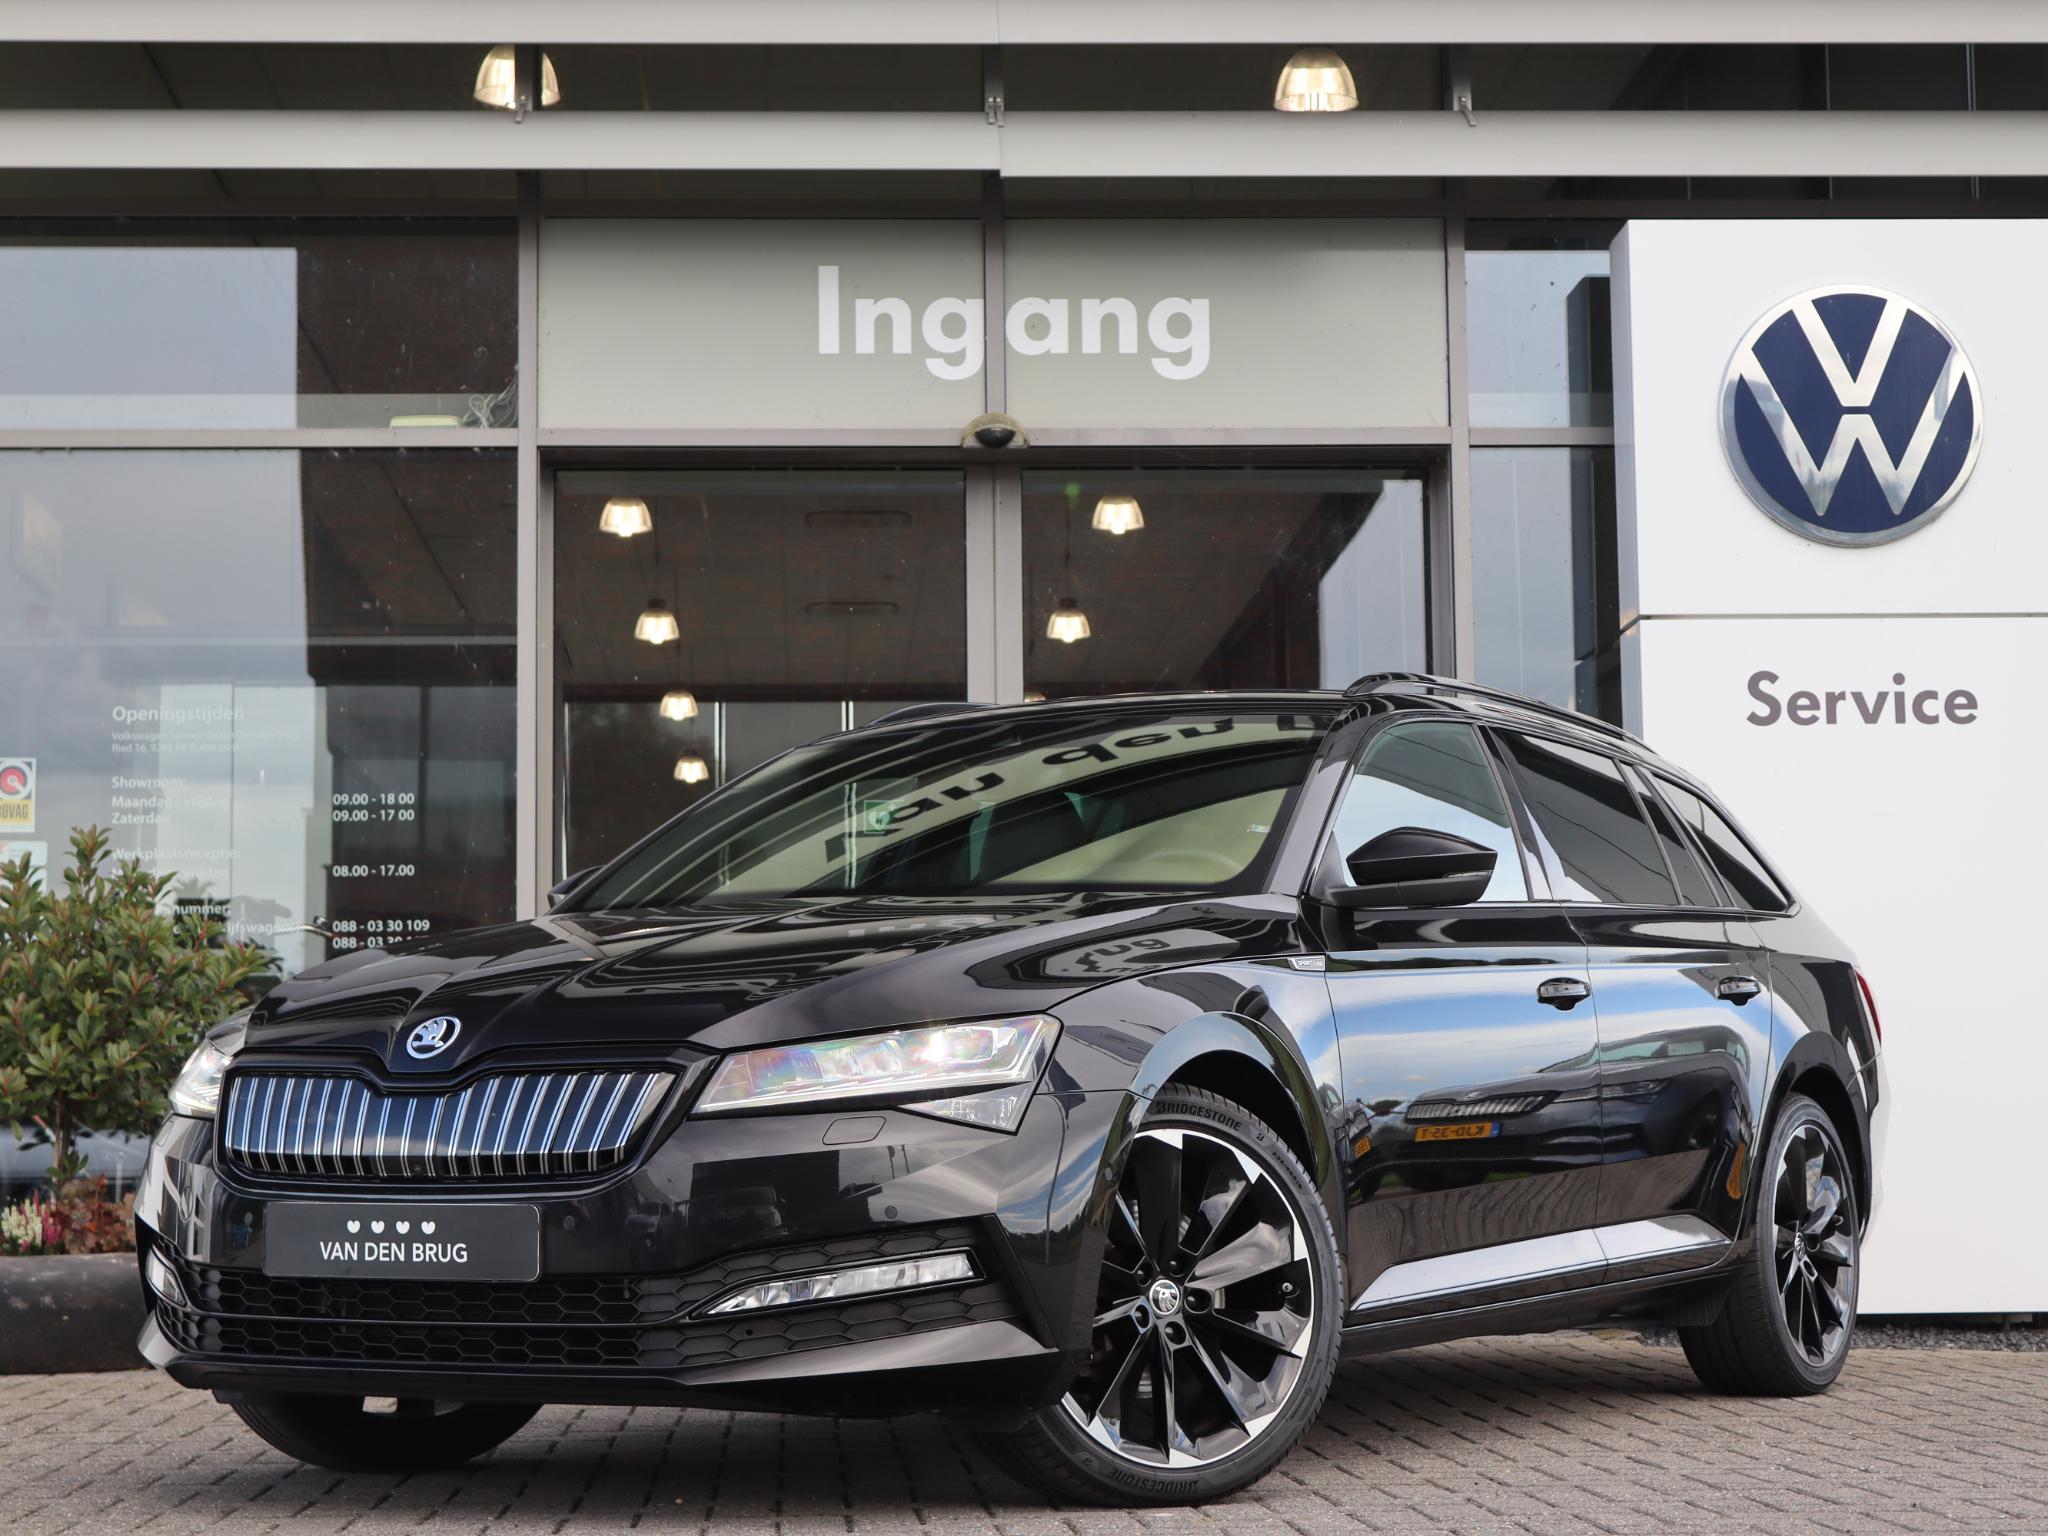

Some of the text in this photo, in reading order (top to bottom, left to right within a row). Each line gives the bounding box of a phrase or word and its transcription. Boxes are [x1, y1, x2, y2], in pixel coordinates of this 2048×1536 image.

[818, 265, 1211, 380] Ingang
[1746, 670, 1979, 727] Service
[112, 706, 245, 725] Openingstijden
[112, 743, 133, 754] Ried
[112, 775, 187, 790] Showroom:
[112, 796, 173, 811] Maandag
[332, 793, 369, 806] 09.00
[112, 812, 171, 826] Zaterdag
[332, 809, 369, 822] 09.00
[332, 864, 369, 877] 08.00
[380, 864, 415, 876] 17.00
[332, 920, 357, 933] 088
[367, 920, 384, 932] 03
[387, 920, 403, 932] 30
[407, 919, 430, 931] 109
[332, 936, 357, 949] 088
[1155, 1101, 1243, 1132] BRIDGESTONE
[320, 1241, 468, 1263] VAN DEN BRUG
[1107, 1467, 1200, 1494] BRIDGESTONE
